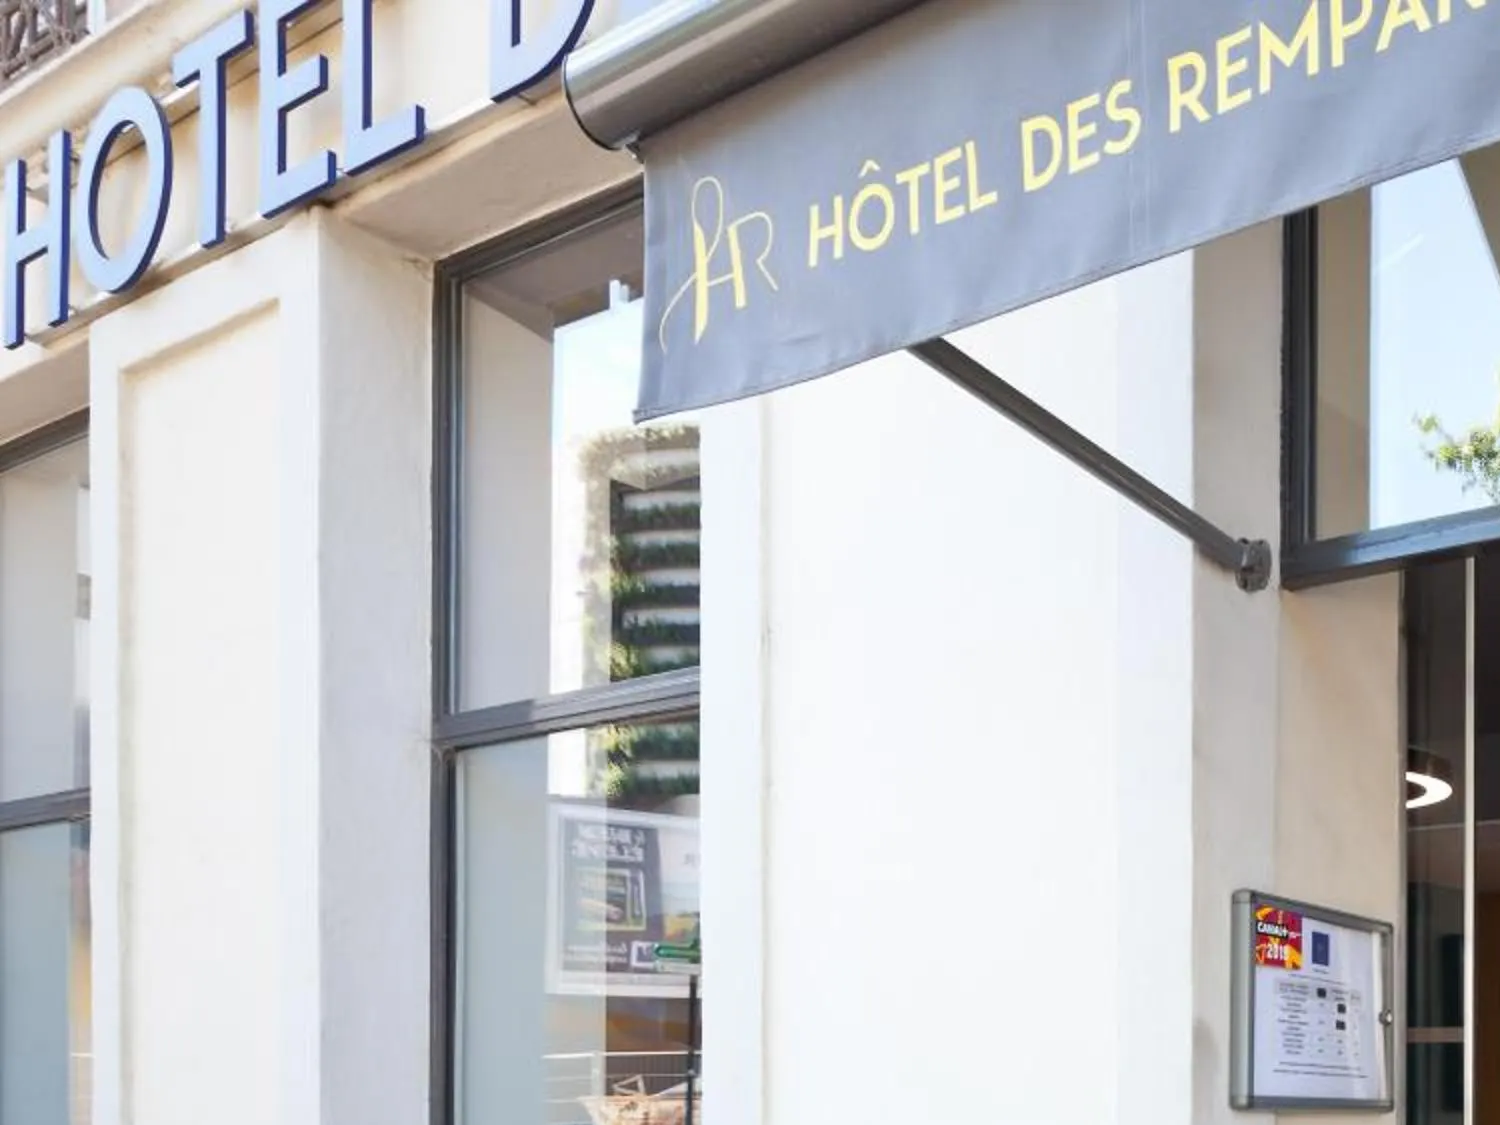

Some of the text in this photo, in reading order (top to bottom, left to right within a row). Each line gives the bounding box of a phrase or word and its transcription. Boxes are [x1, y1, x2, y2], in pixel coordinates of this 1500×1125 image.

[3, 0, 427, 350] HOTEL
[807, 141, 998, 267] HÔTEL
[1020, 80, 1142, 193] DES
